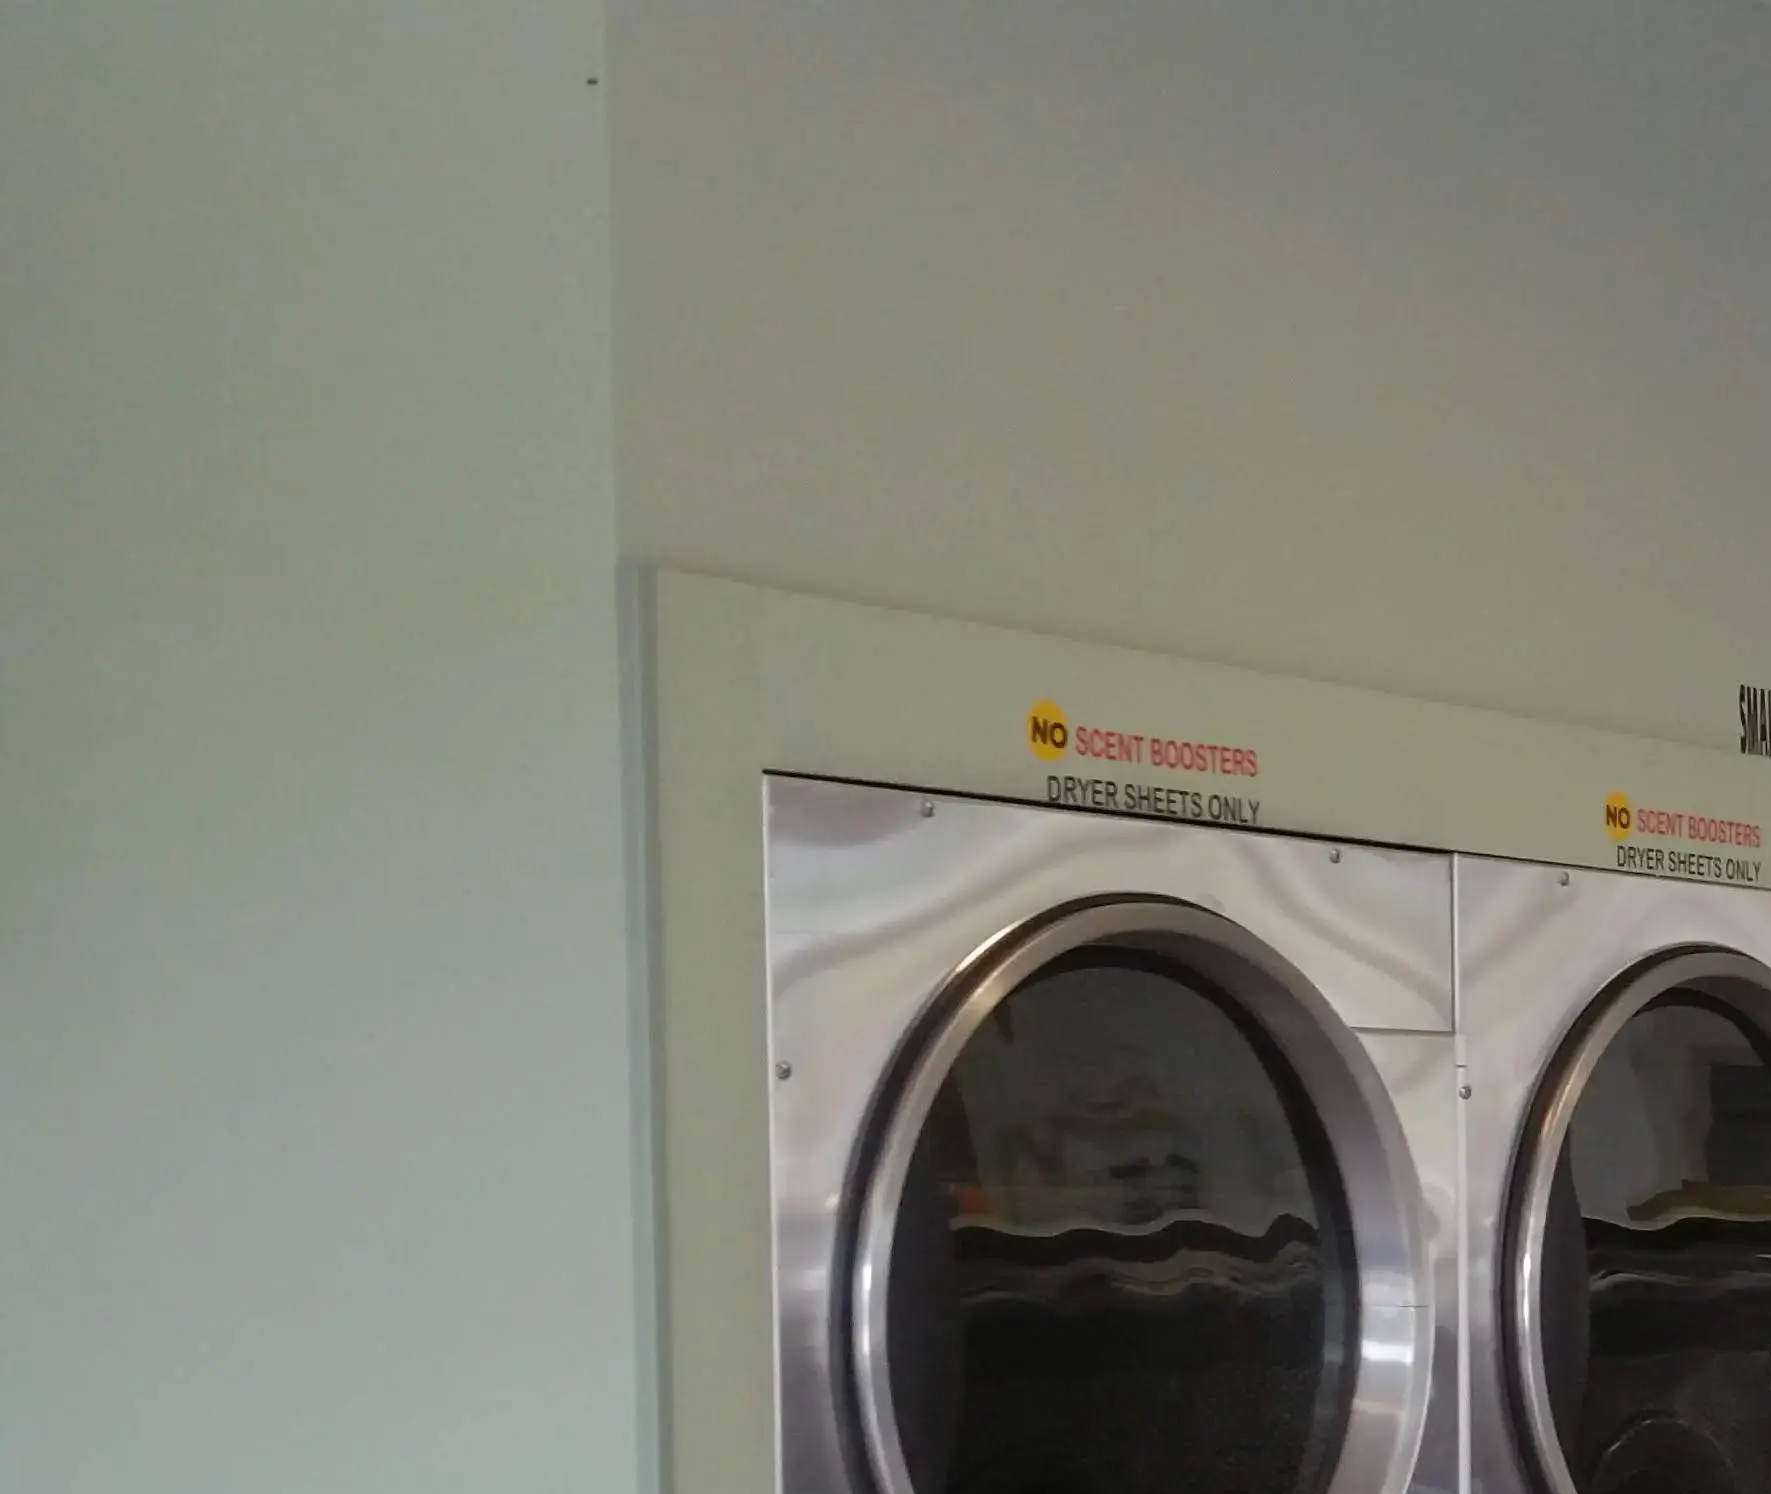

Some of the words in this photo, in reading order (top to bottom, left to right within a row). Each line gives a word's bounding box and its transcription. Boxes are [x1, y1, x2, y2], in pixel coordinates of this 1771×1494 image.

[1031, 715, 1068, 749] NO
[1075, 725, 1144, 764] SCENT
[1150, 738, 1258, 778] BOOSTERS
[1047, 775, 1118, 810] DRYER
[1124, 783, 1203, 818] SHEETS
[1208, 794, 1260, 825] ONLY
[1605, 804, 1631, 829] NO
[1637, 808, 1684, 838] SCENT
[1688, 815, 1761, 848] BOOSTERS
[1616, 845, 1665, 871] DRYER
[1668, 850, 1722, 878] SHEETS
[1725, 858, 1762, 882] ONLY
